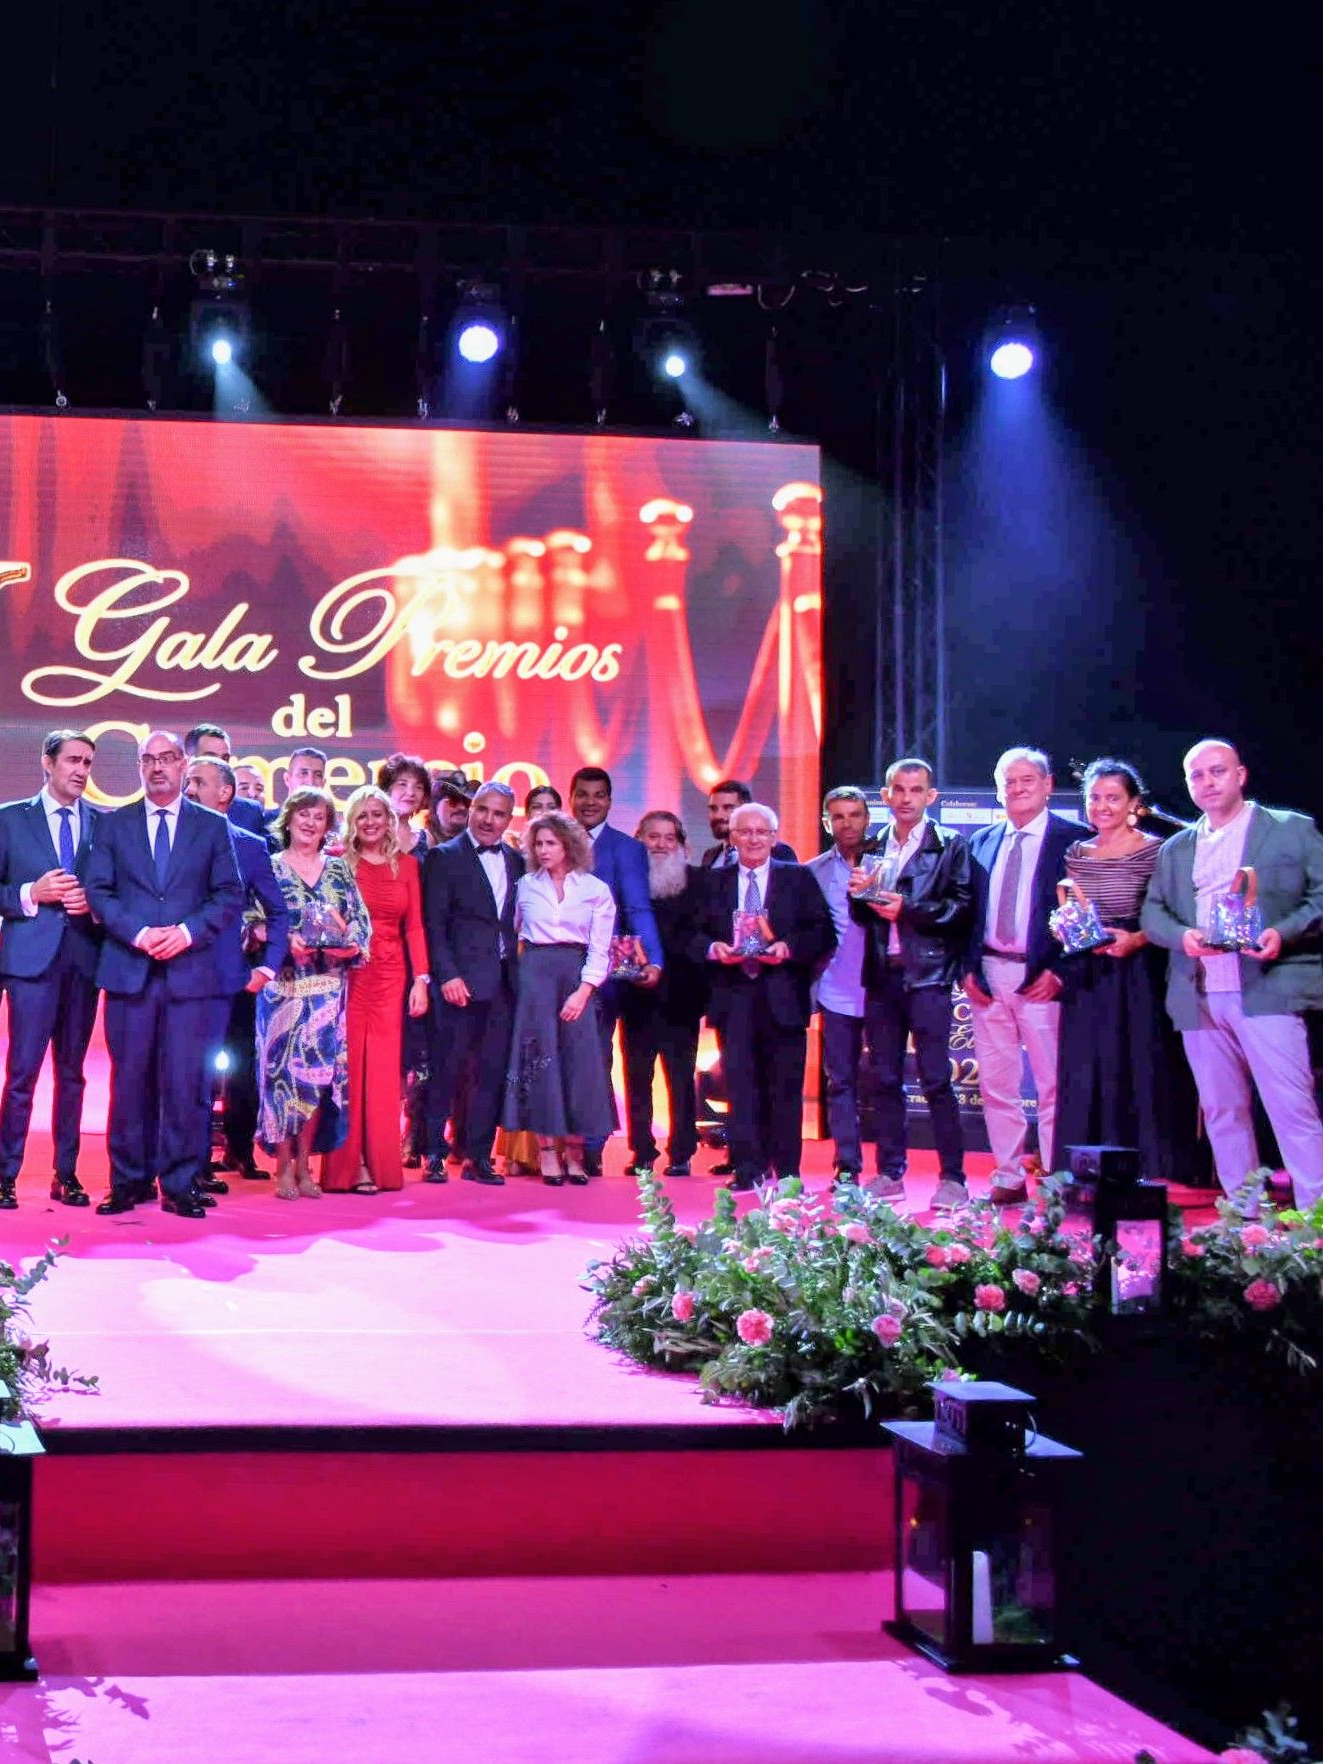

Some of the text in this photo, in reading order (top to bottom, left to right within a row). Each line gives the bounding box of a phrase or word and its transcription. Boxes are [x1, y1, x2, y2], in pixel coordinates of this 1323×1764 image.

[20, 558, 624, 707] Gala Premios
[271, 692, 354, 739] del
